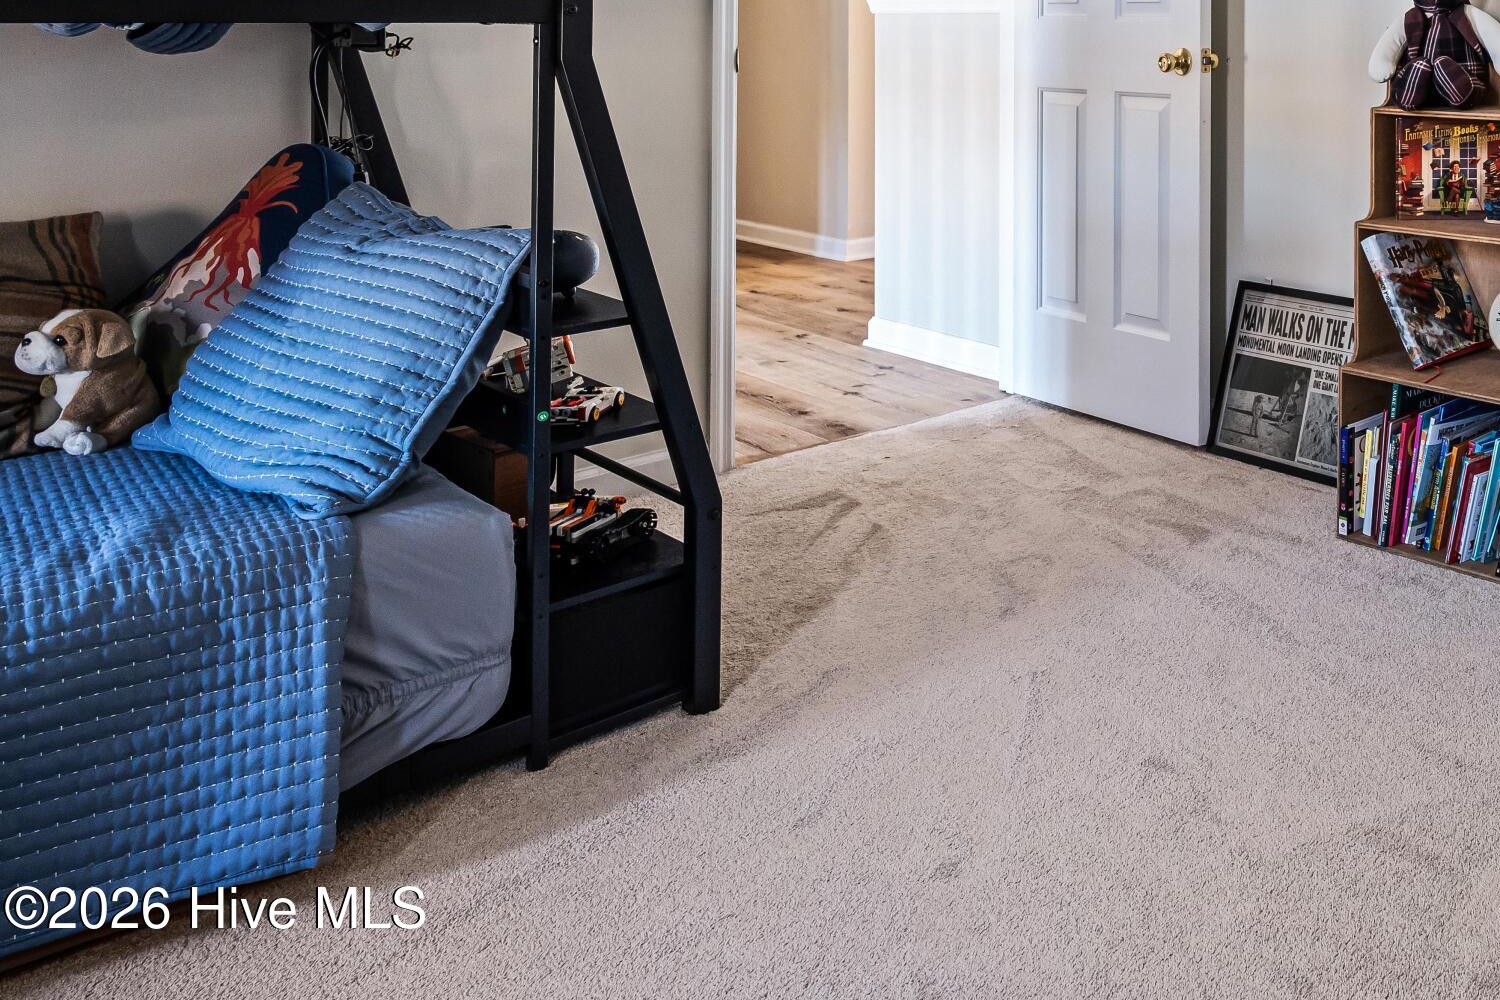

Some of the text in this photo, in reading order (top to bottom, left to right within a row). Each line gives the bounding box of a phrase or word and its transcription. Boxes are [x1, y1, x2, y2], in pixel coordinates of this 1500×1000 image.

[1240, 303, 1267, 333] MAN
[1267, 308, 1306, 341] WALKS
[1305, 314, 1324, 344] ON
[1324, 318, 1348, 349] THE
[1237, 335, 1276, 354] MONUMENTAL
[1276, 342, 1295, 357] MOON
[1295, 345, 1322, 363] LANDING
[1322, 350, 1344, 367] OPENS
